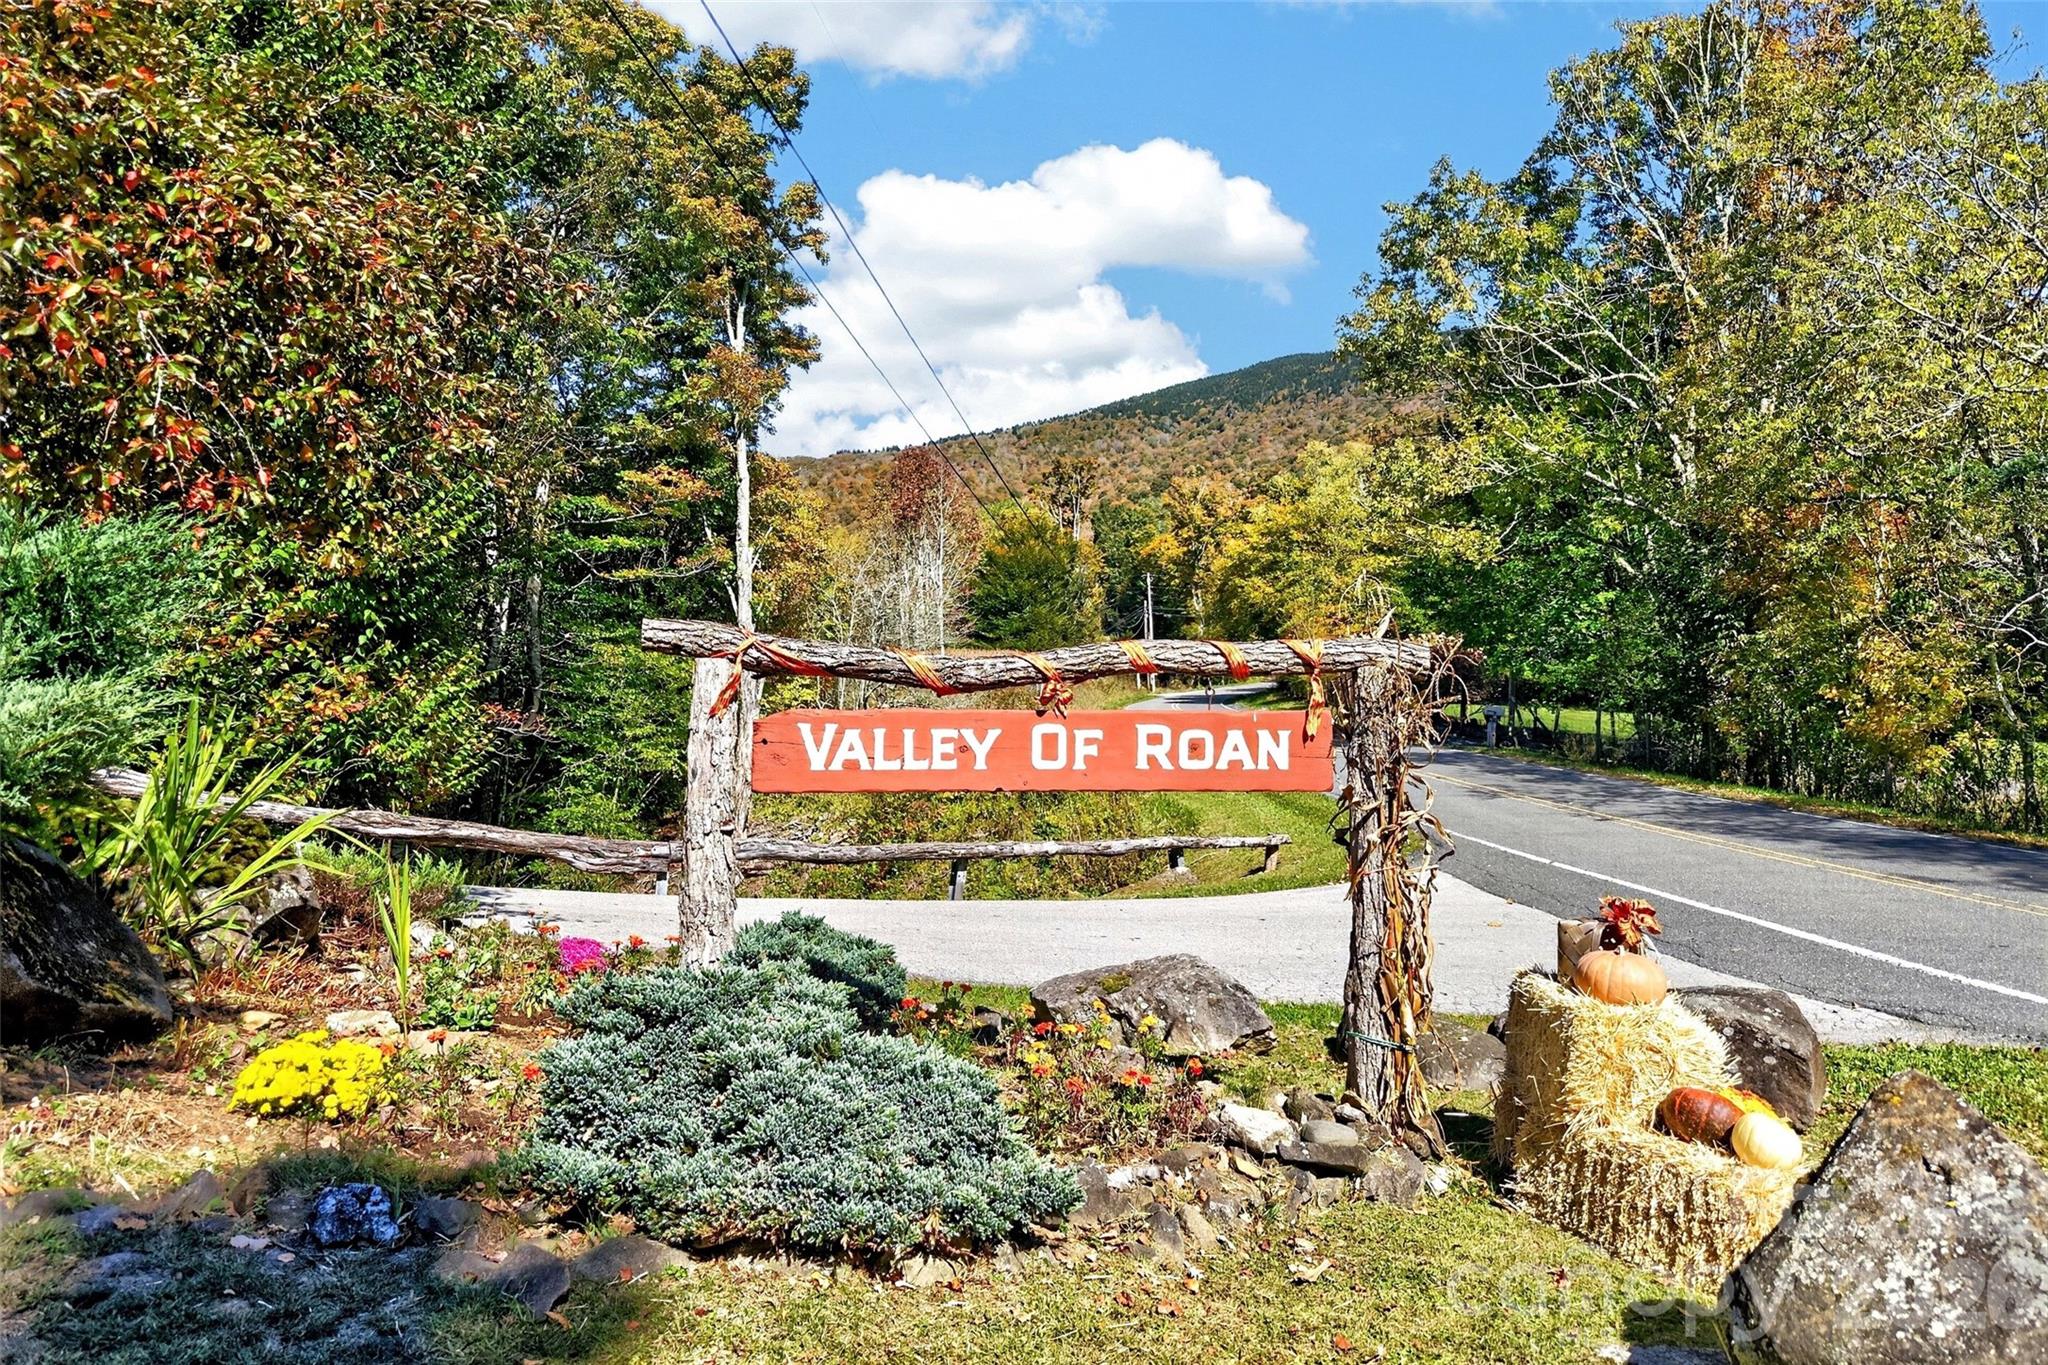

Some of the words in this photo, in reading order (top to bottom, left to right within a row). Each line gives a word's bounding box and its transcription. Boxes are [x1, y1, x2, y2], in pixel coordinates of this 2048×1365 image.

[797, 722, 1002, 771] VALLEY
[1031, 722, 1104, 771] OF
[1135, 723, 1292, 771] ROAN
